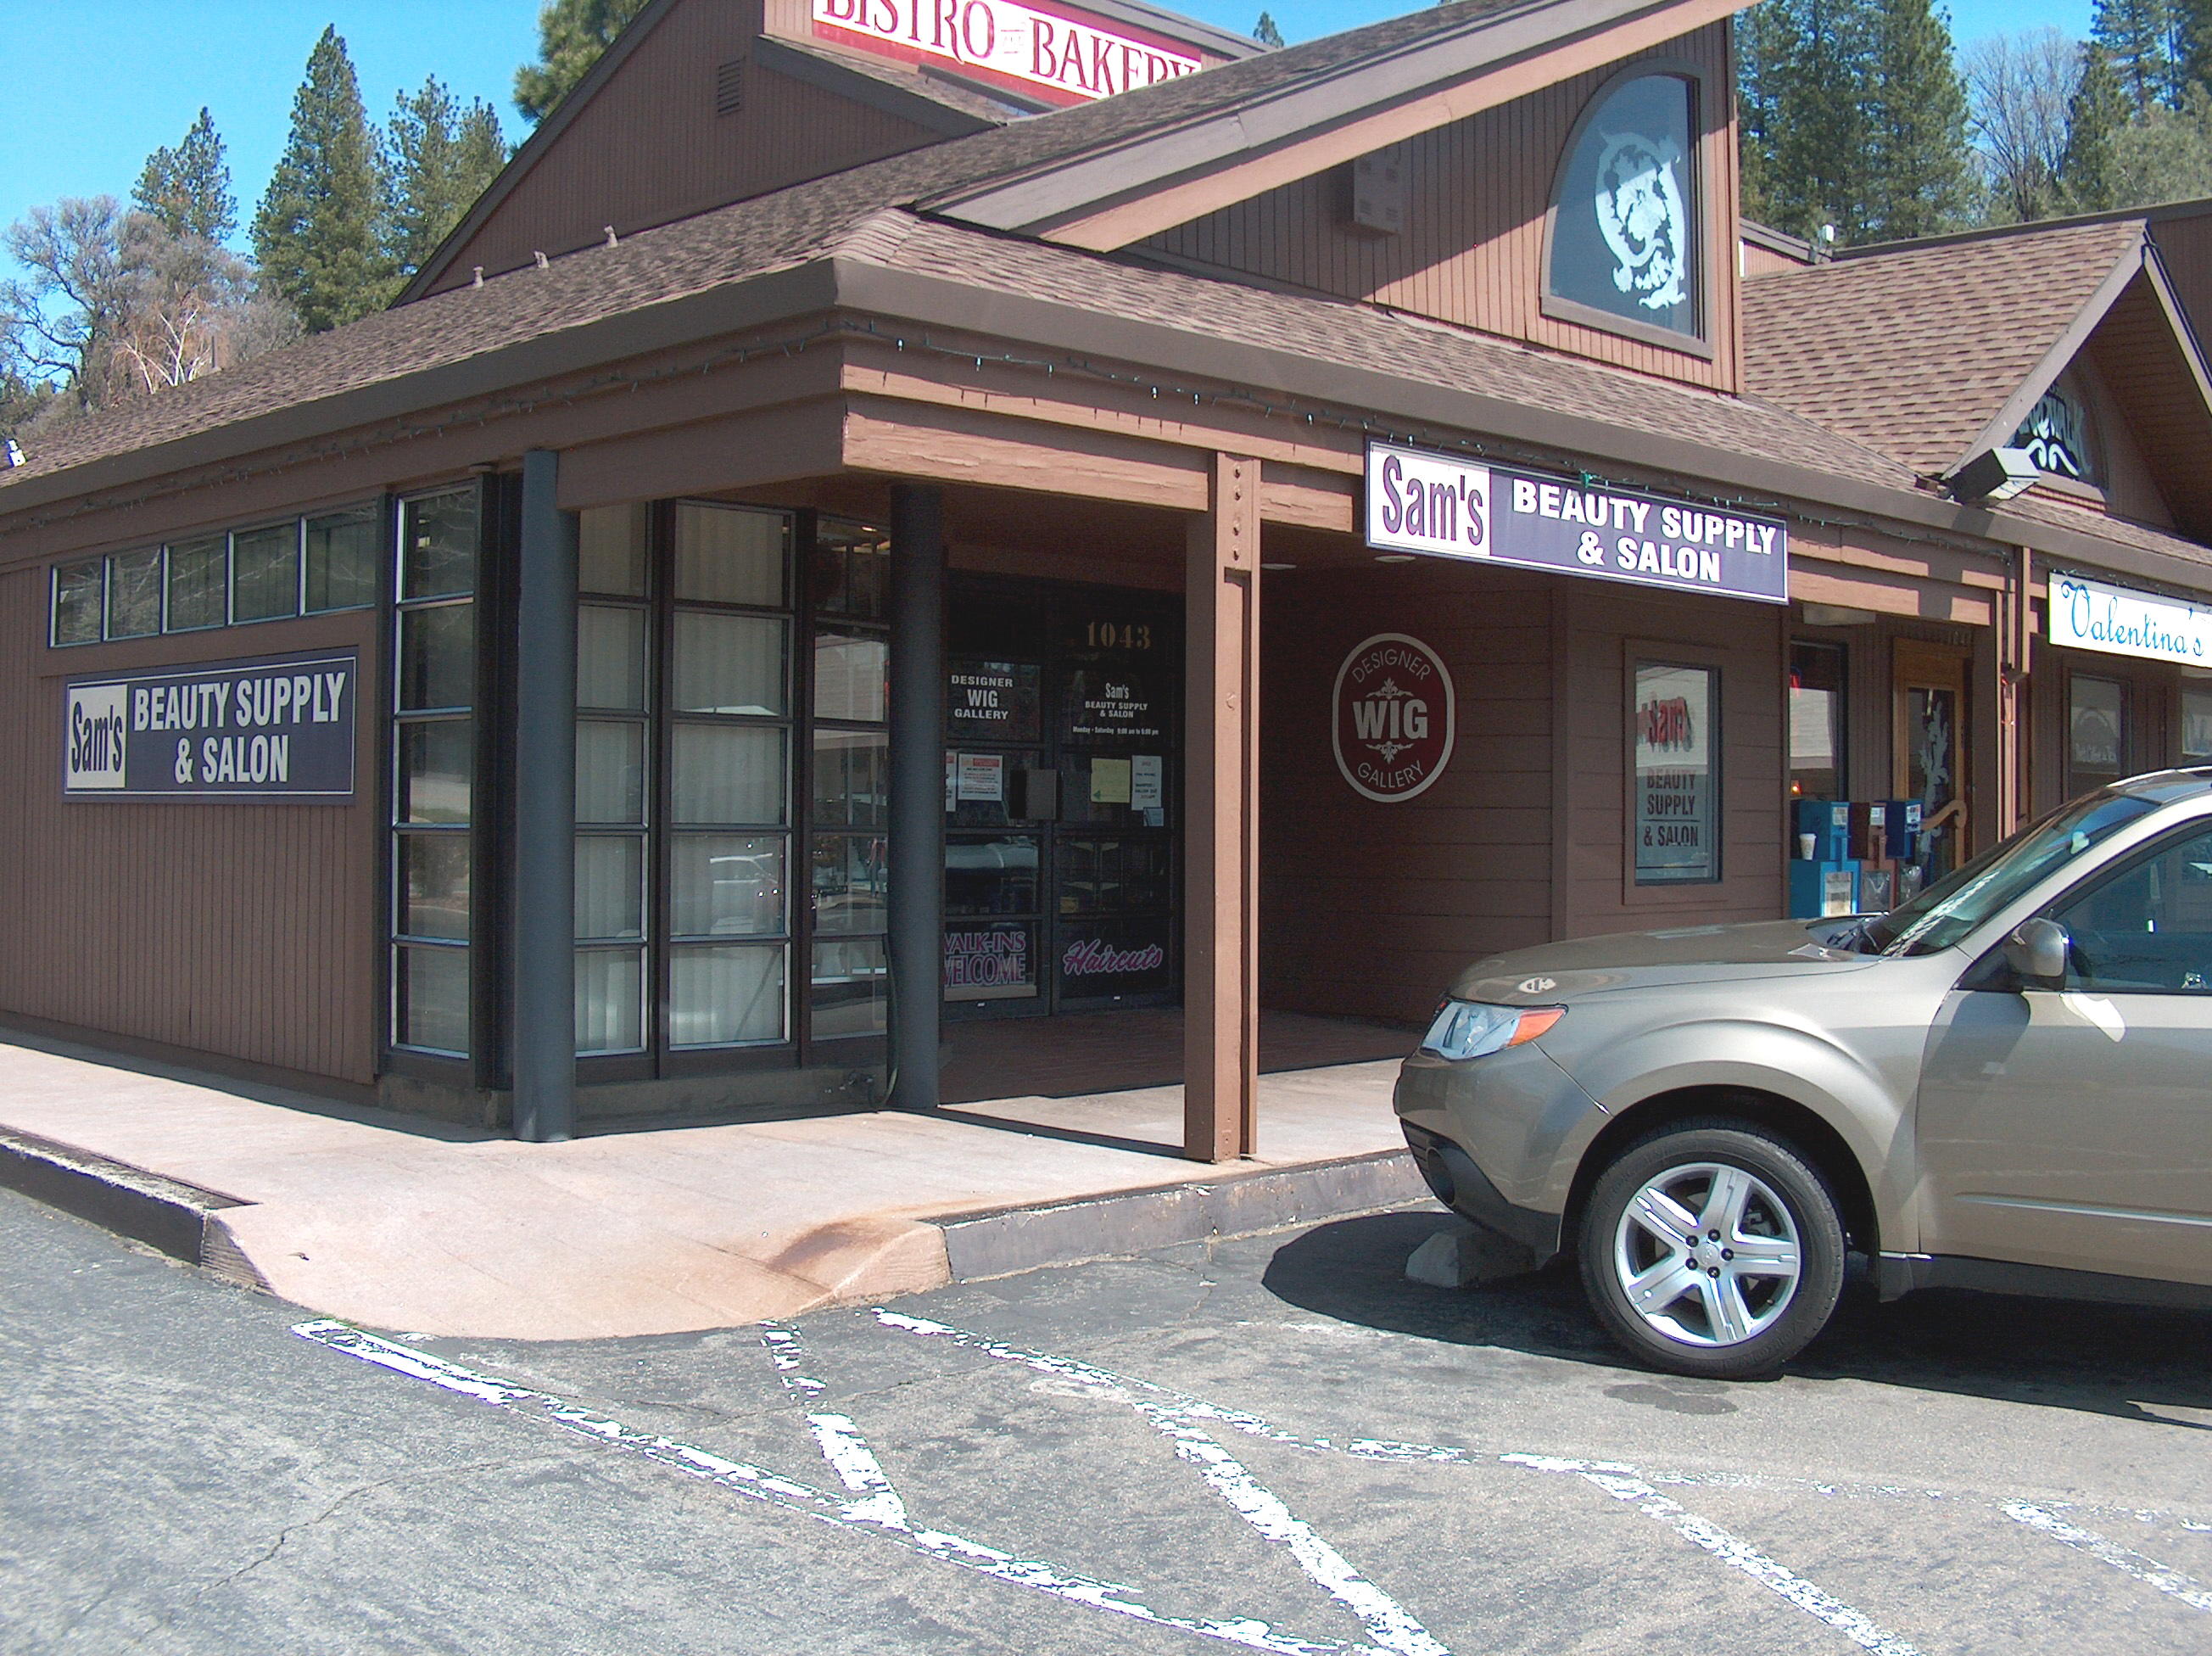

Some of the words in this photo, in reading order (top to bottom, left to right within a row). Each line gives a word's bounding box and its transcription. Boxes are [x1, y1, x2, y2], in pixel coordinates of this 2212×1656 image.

[1382, 455, 1483, 546] Sam's
[1512, 478, 1651, 534] BEAUTY
[1662, 506, 1777, 555] SUPPLY
[1578, 531, 1604, 566] &
[1616, 537, 1721, 583] SALON
[2061, 580, 2204, 657] Valentina's
[1087, 621, 1152, 649] 1043
[951, 674, 1014, 687] DESIGNER
[1352, 648, 1432, 682] DESIGNER
[134, 681, 231, 731] BEAUTY
[235, 672, 346, 727] SUPPLY
[967, 689, 998, 708] WIG
[1085, 701, 1116, 709] BEAUTY
[1119, 702, 1148, 711] SUPPLY
[1105, 682, 1130, 699] Sam's
[954, 708, 1009, 720] GALLERY
[1352, 699, 1428, 740] WIG
[71, 701, 123, 773] Sam's
[175, 737, 193, 784] &
[201, 735, 288, 783] SALON
[1358, 760, 1425, 788] GALLERY
[1646, 769, 1696, 790] BEAUTY
[1647, 794, 1695, 815] SUPPLY
[1644, 825, 1653, 847] &
[1658, 825, 1699, 848] SALON
[1063, 938, 1164, 976] Haircuts
